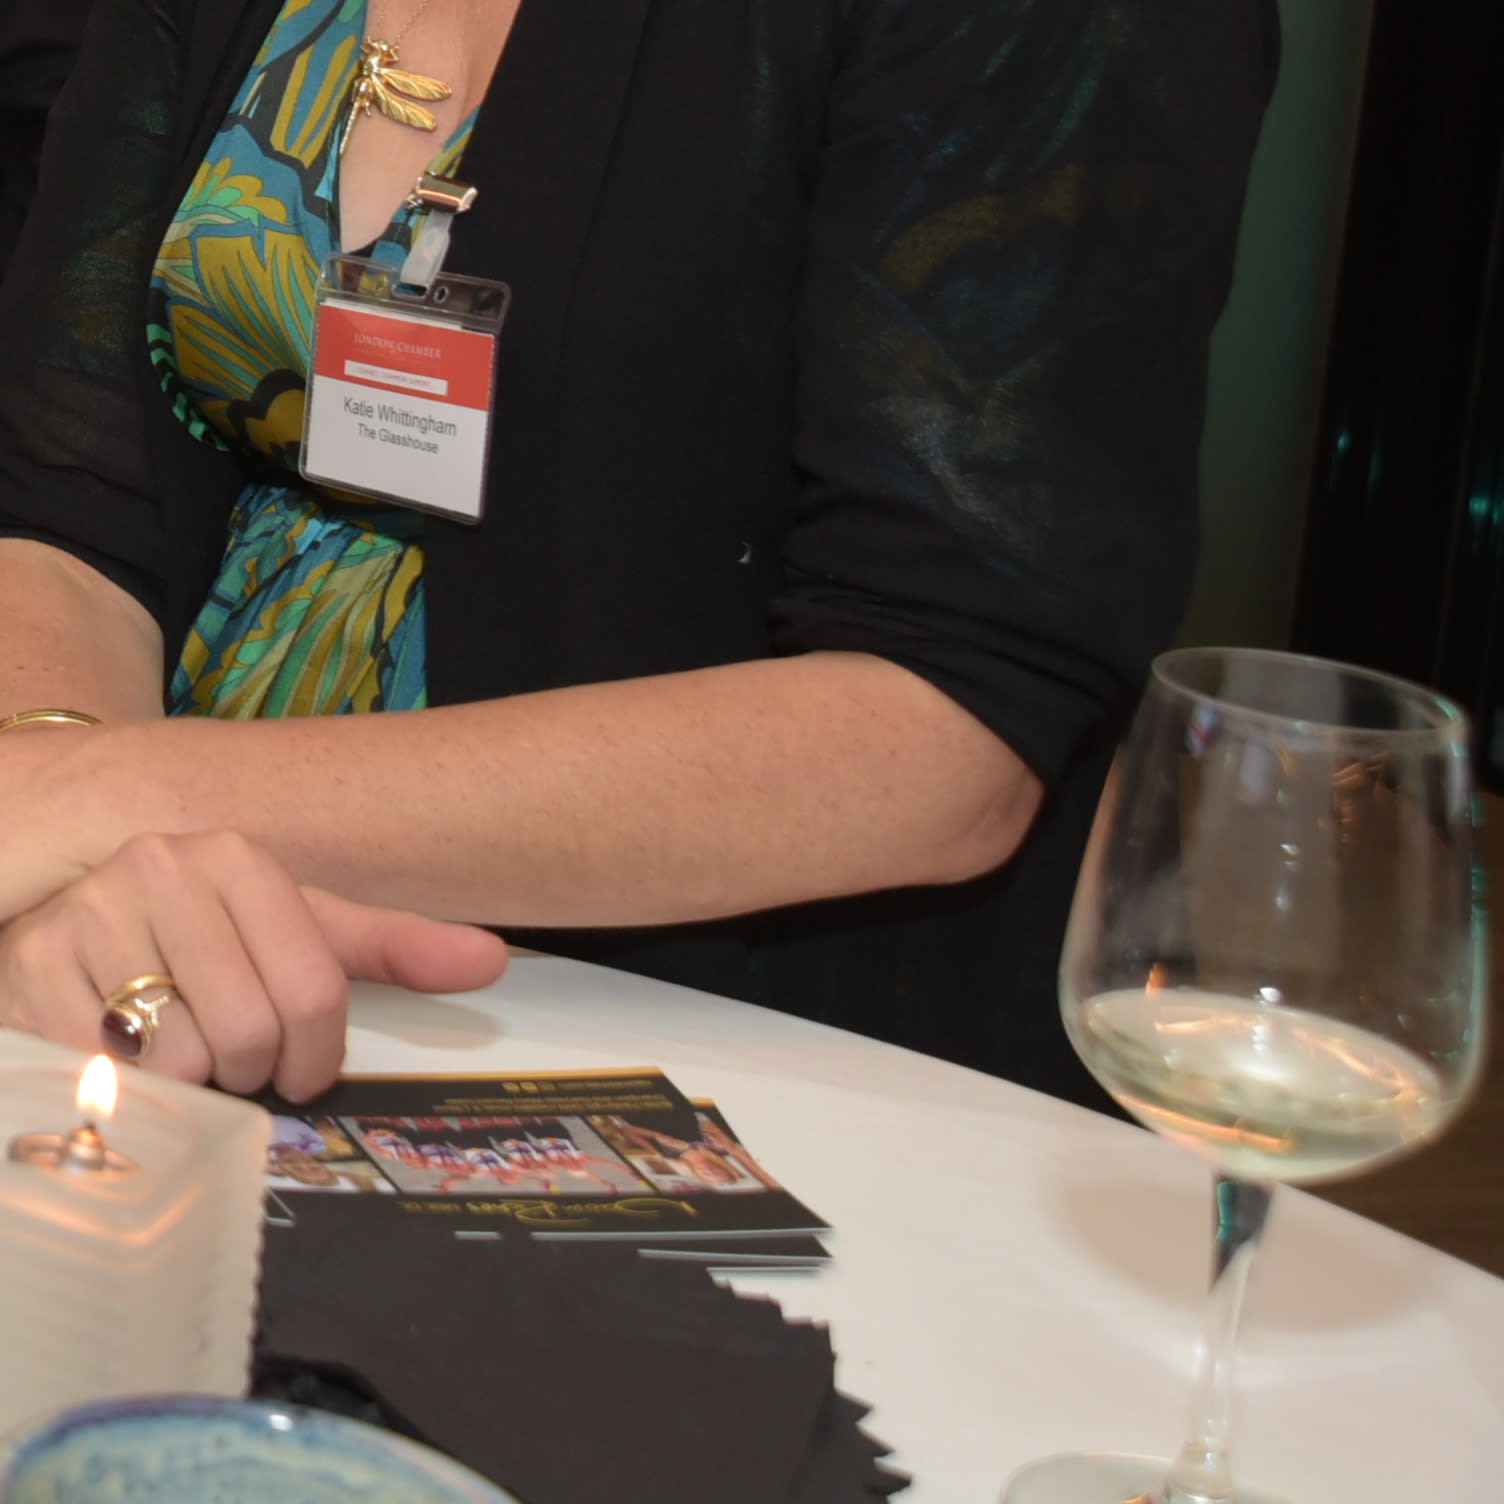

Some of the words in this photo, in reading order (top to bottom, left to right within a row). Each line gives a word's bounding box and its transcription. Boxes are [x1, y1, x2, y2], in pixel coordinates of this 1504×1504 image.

[344, 396, 374, 419] Katie
[377, 403, 457, 437] Whittingham
[358, 423, 376, 439] The
[378, 428, 439, 454] Glasshouse
